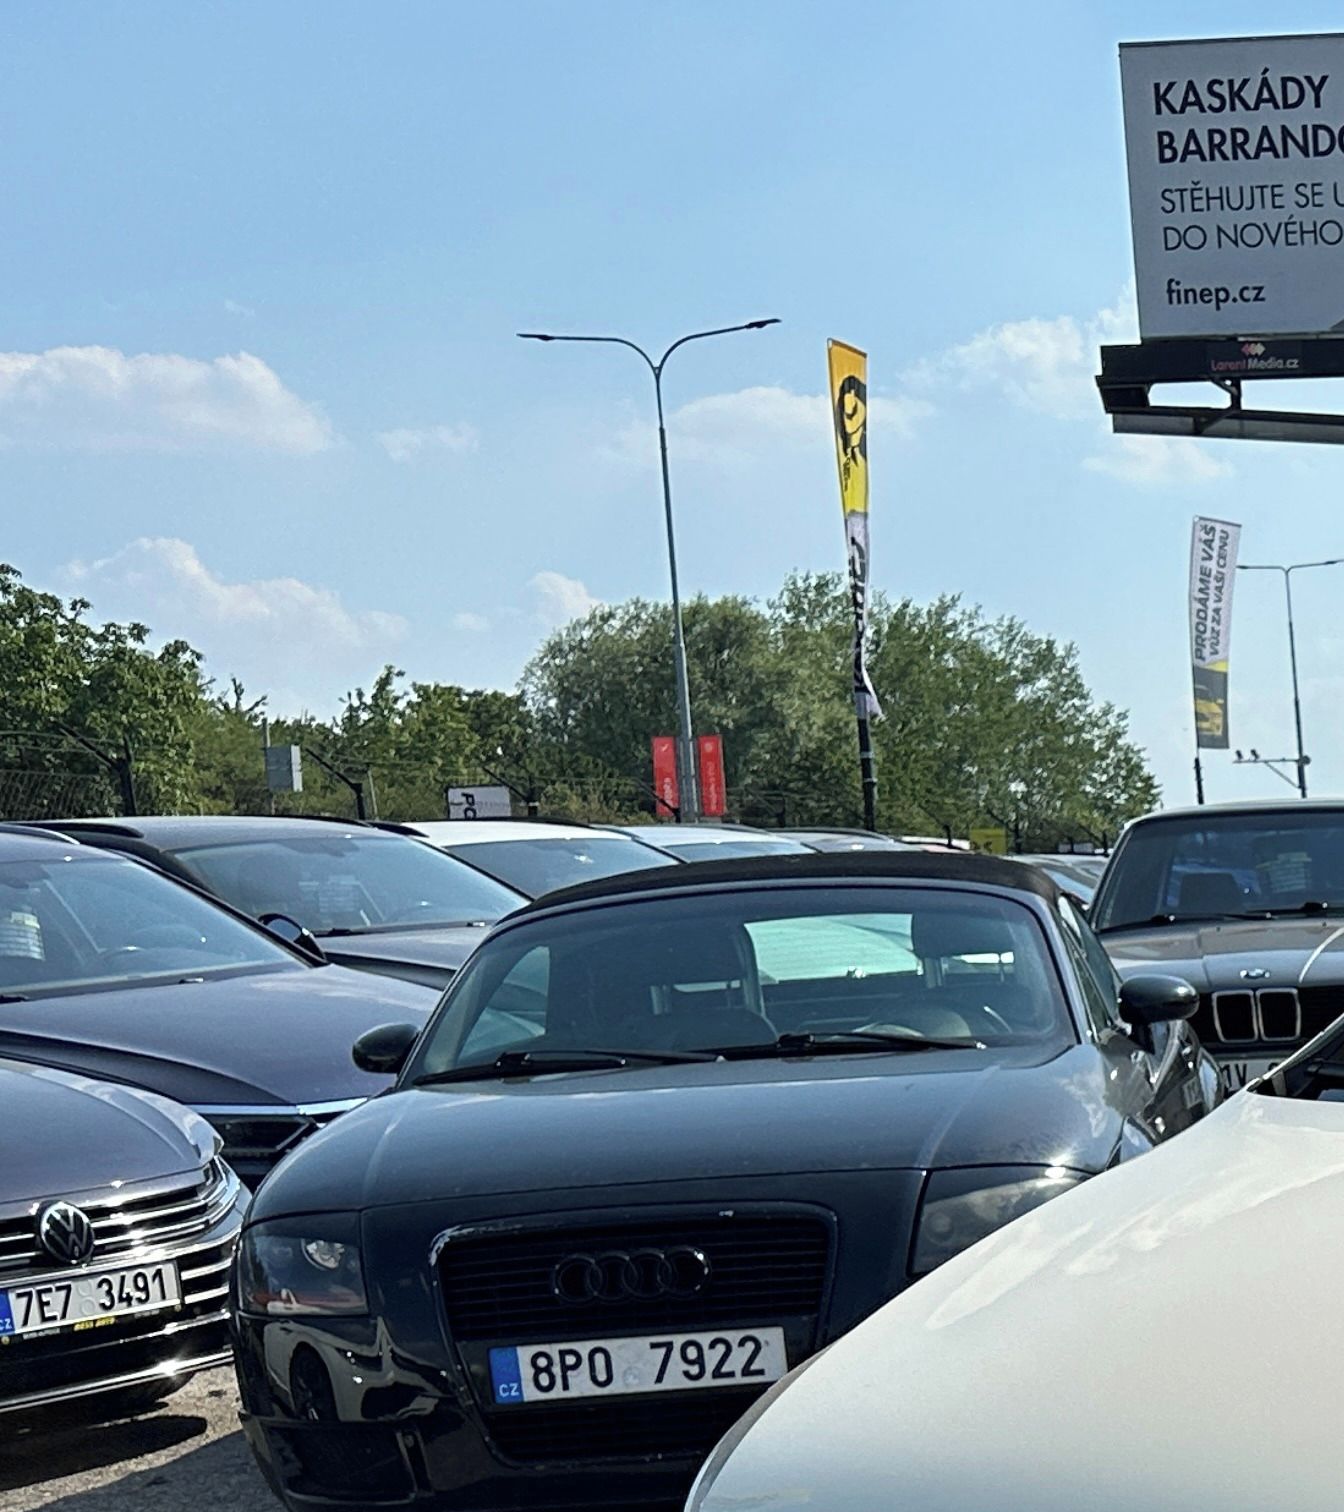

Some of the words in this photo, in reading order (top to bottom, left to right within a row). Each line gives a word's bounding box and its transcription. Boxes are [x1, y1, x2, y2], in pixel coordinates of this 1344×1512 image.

[1153, 67, 1329, 115] KASKÁDY
[1160, 180, 1285, 214] STĚHUJTE
[1294, 182, 1324, 208] SE
[1163, 224, 1207, 251] DO
[1216, 214, 1343, 249] NOVÉHO
[1166, 278, 1266, 311] finep.cz
[1216, 529, 1230, 569] CENU
[1194, 565, 1212, 661] PRODÁME
[15, 1283, 73, 1327] 7E7
[97, 1268, 167, 1311] 3491
[530, 1346, 614, 1393] 8P0
[650, 1335, 765, 1384] 7922
[499, 1383, 520, 1398] CZ
